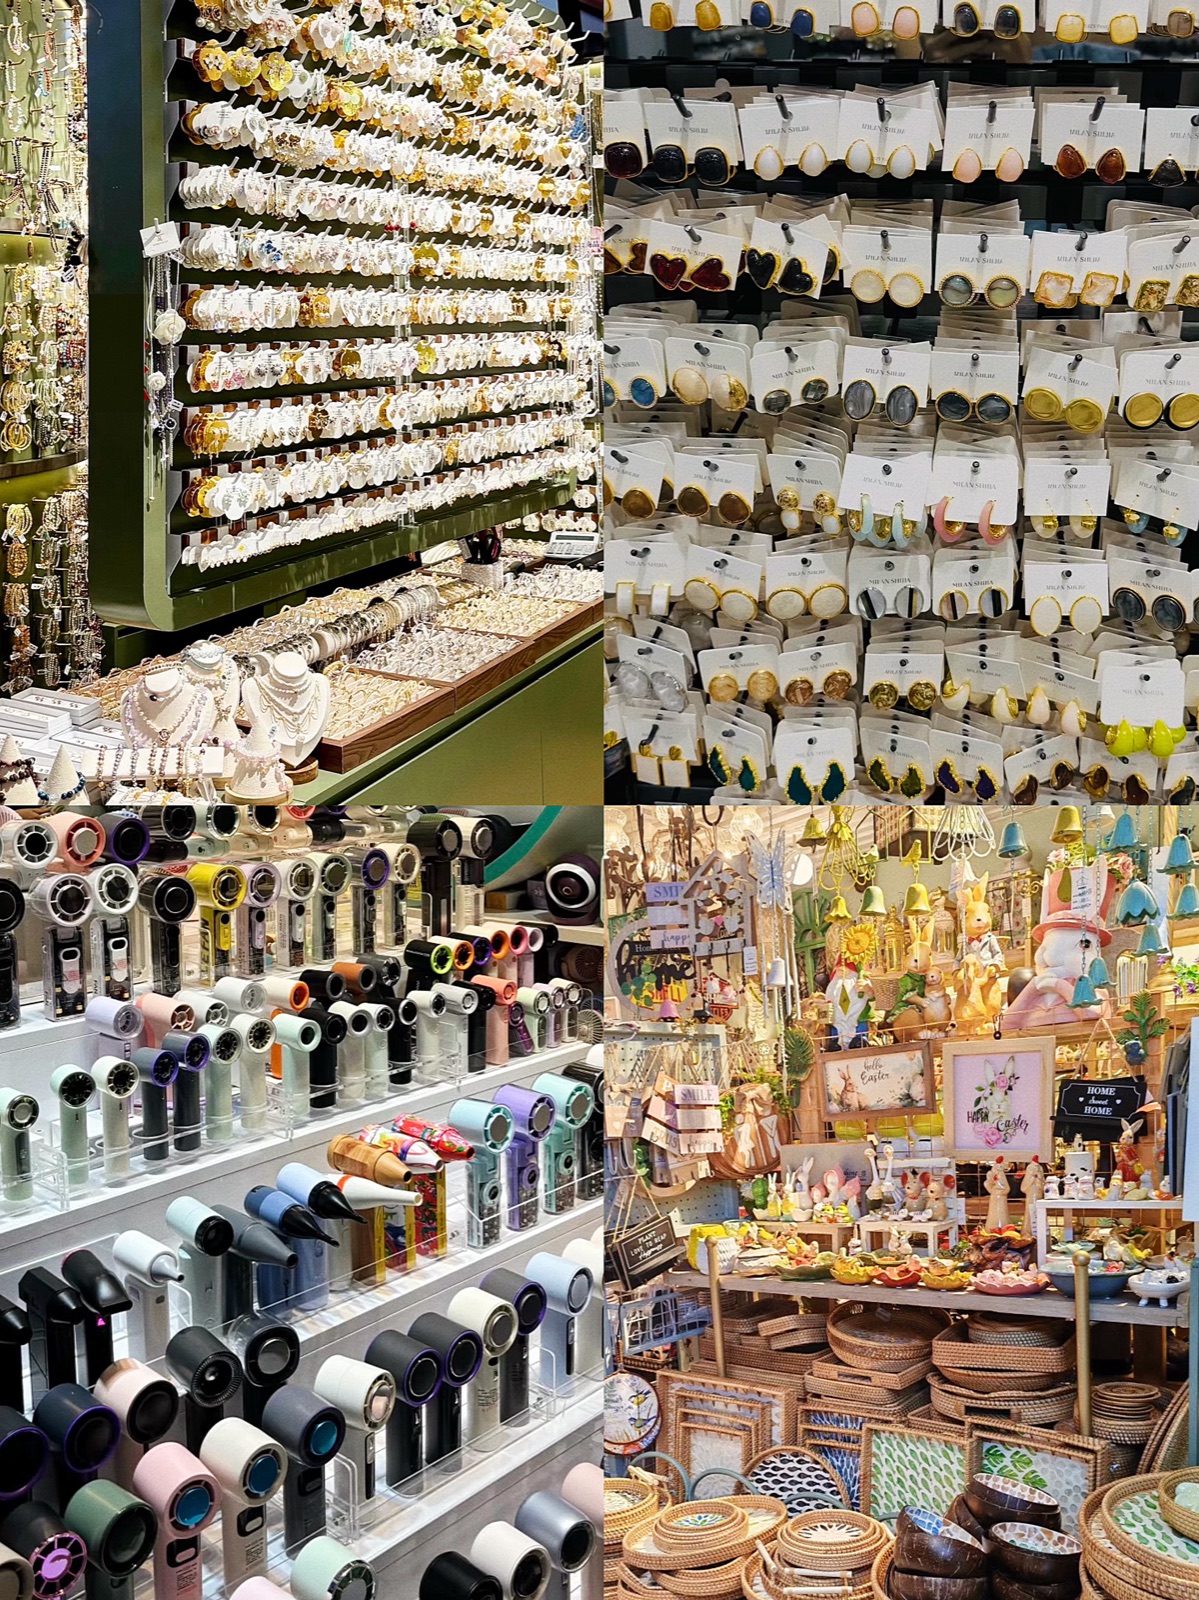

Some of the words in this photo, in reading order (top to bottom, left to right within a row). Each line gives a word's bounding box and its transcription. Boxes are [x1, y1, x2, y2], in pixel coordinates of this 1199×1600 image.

[864, 1058, 884, 1071] hello
[861, 1070, 889, 1085] Easter
[681, 1088, 714, 1101] SMILE
[1087, 1087, 1116, 1095] HOME
[967, 1109, 989, 1123] HAPPY
[1084, 1106, 1112, 1115] HOME
[992, 1114, 1028, 1135] Easter
[638, 1231, 656, 1244] PLANT
[630, 1246, 643, 1256] LOVE
[654, 1233, 666, 1243] REAP
